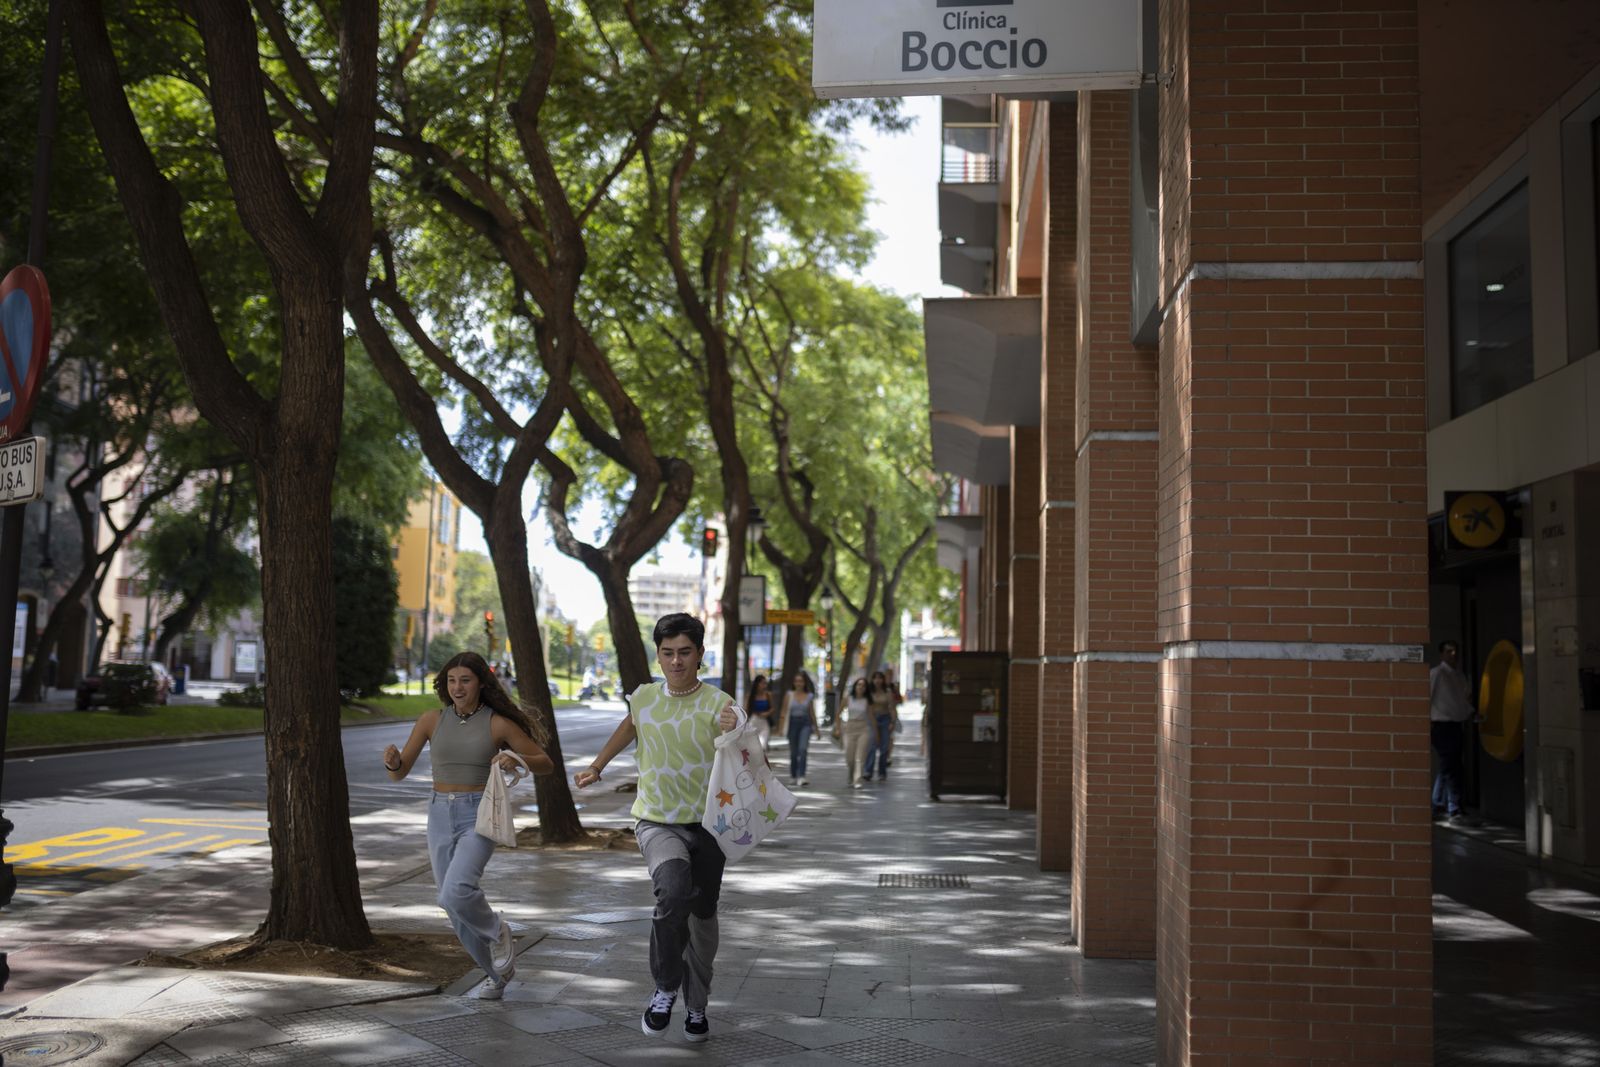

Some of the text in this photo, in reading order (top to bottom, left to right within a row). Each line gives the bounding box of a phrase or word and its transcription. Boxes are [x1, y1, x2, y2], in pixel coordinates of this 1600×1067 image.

[943, 11, 1007, 30] Clínica
[901, 27, 1048, 72] Boccio
[0, 445, 32, 468] O BUS
